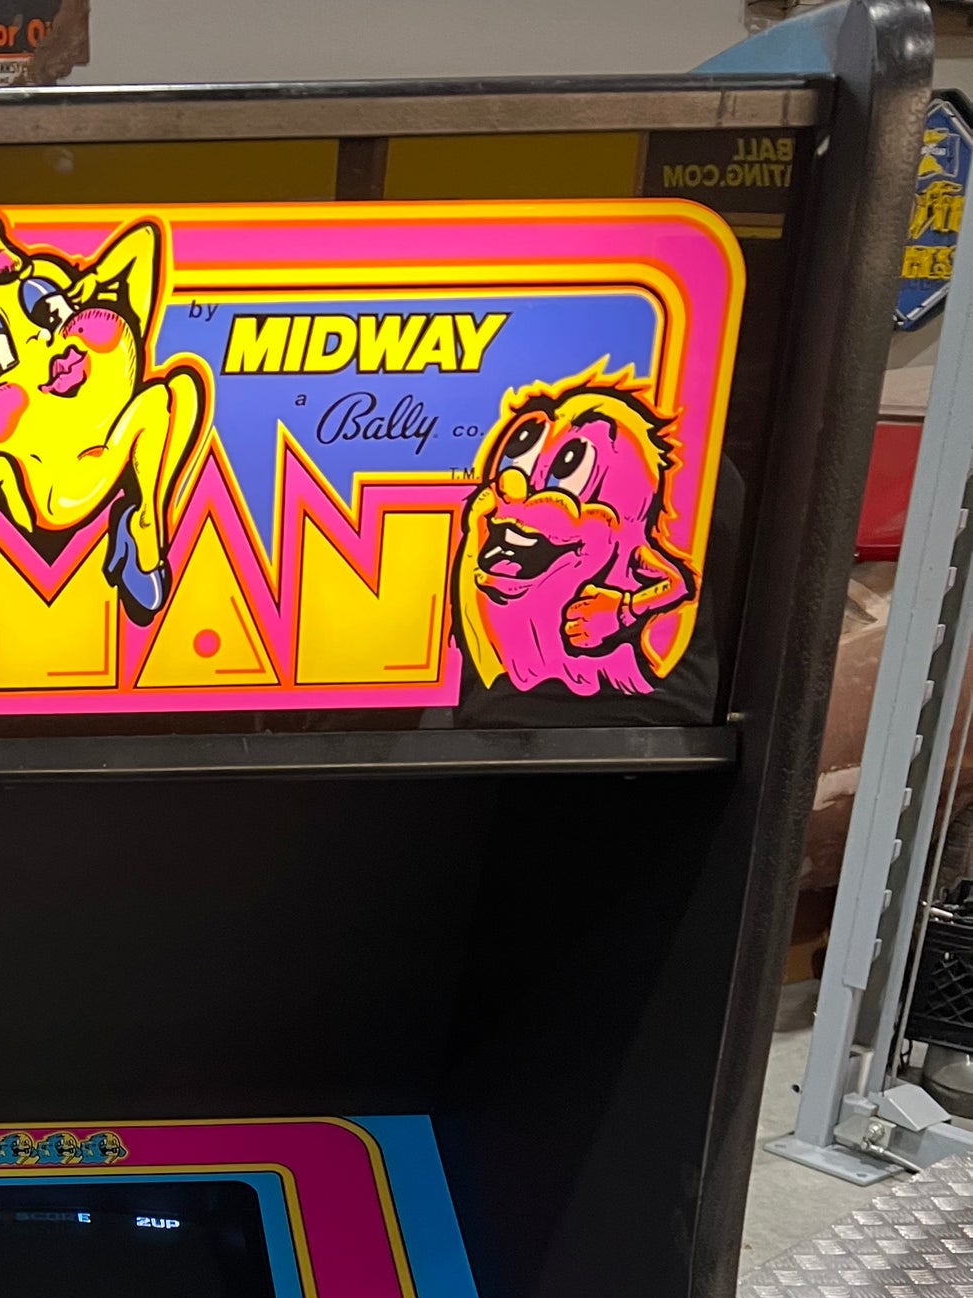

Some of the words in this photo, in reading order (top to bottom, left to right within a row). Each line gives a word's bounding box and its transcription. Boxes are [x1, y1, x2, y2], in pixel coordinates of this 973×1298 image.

[188, 300, 220, 322] by
[221, 312, 512, 376] MIDWAY
[295, 392, 307, 407] a
[316, 391, 438, 456] Bally
[452, 424, 485, 438] co.
[14, 1212, 91, 1223] SCORE
[136, 1217, 180, 1229] 2UP
